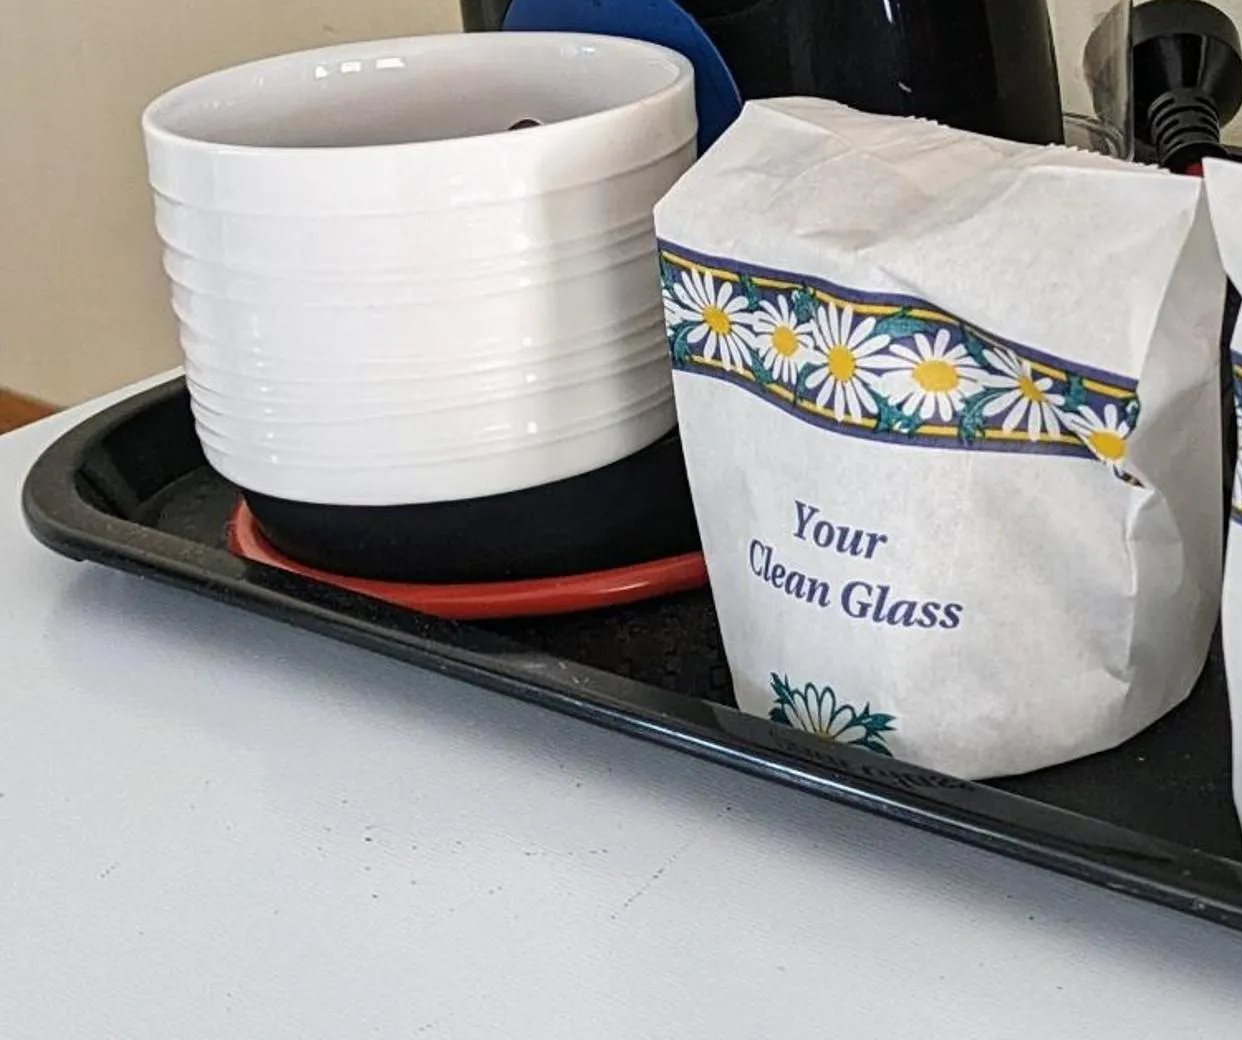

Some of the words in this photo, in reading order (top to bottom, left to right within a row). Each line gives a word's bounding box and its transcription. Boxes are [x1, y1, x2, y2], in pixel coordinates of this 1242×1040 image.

[794, 500, 888, 559] Your
[749, 539, 831, 608] Clean
[840, 580, 964, 630] Glass
